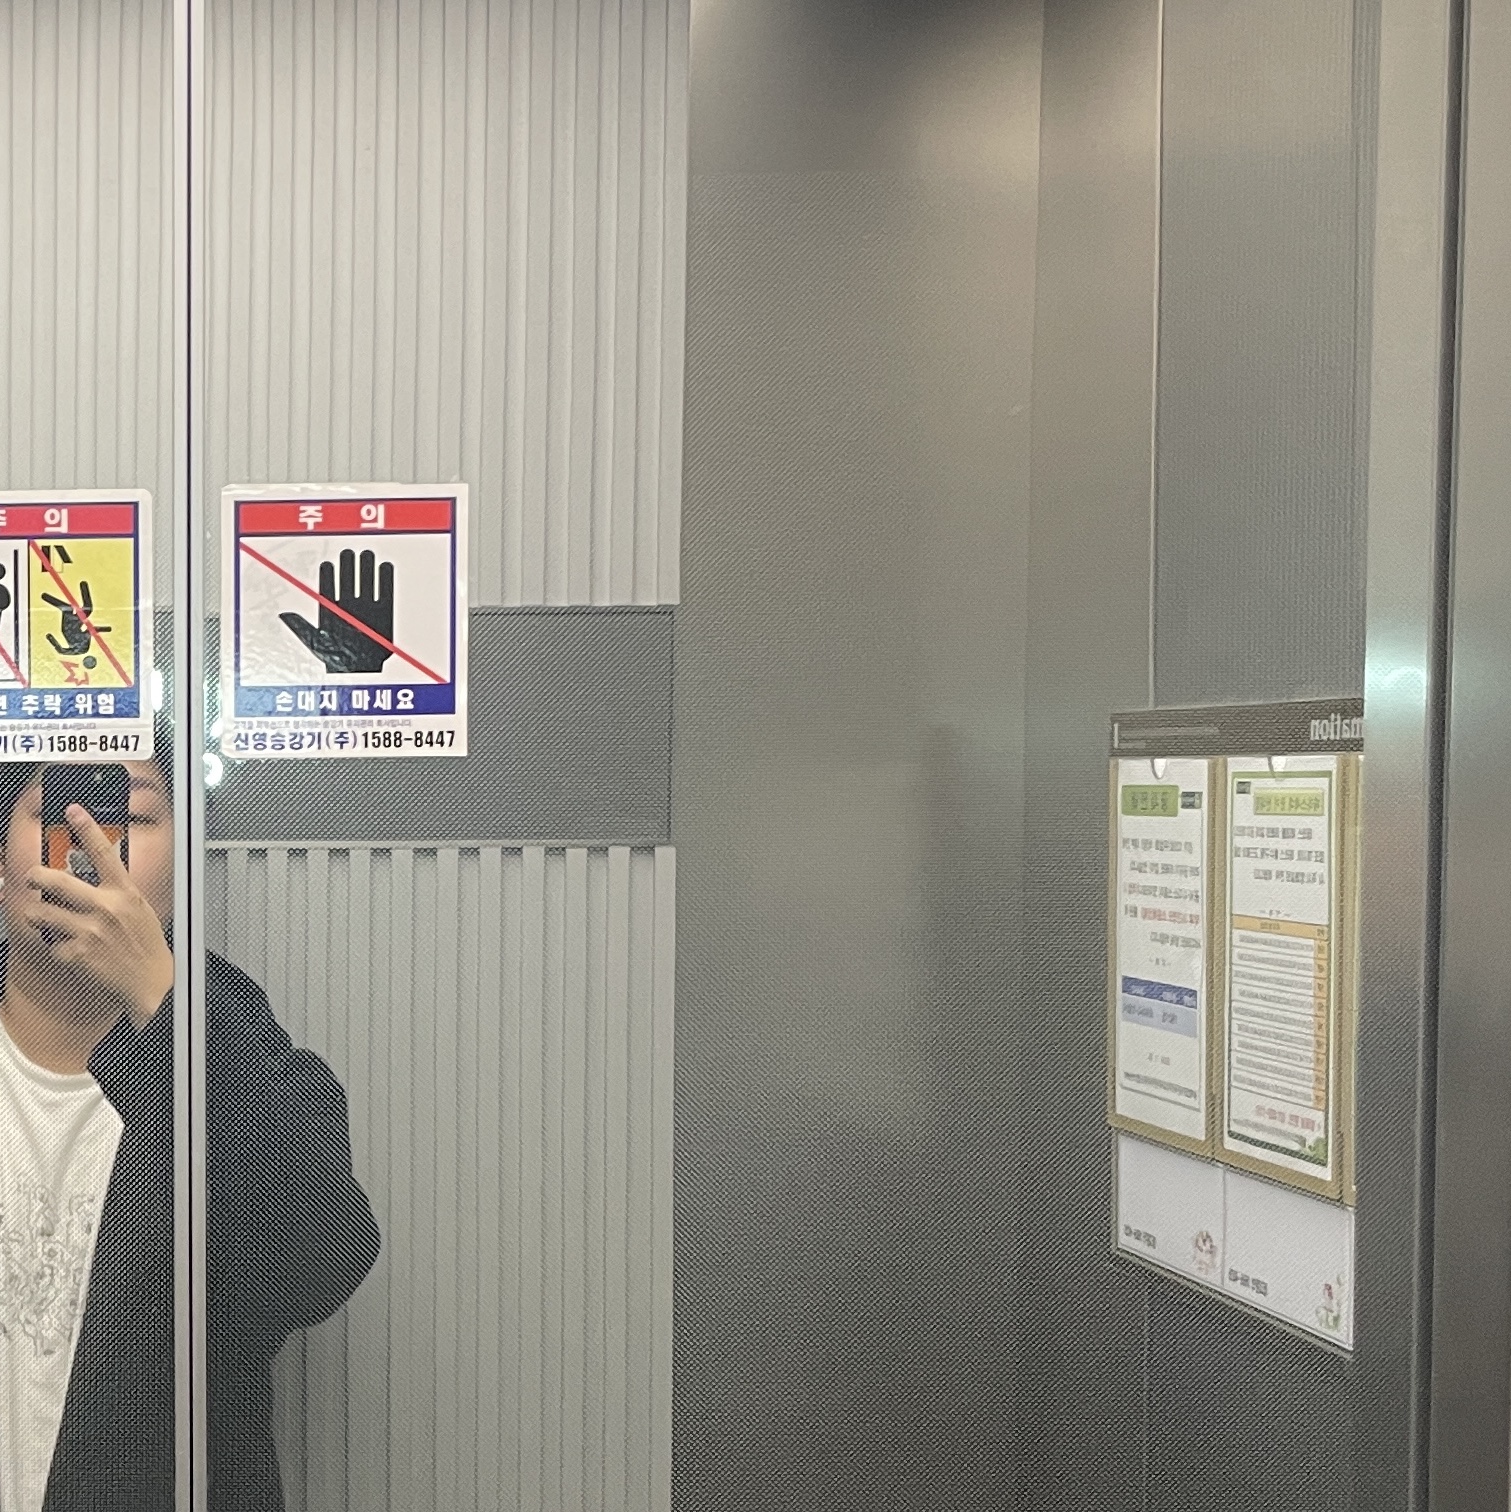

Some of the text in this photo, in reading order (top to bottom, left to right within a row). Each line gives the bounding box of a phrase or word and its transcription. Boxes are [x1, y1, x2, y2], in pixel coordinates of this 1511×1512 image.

[21, 693, 62, 715] 추락
[75, 693, 115, 715] 위험
[275, 688, 415, 712] 손대지 마세요
[47, 734, 140, 753] 1588-8447
[361, 730, 456, 749] 1588-8447
